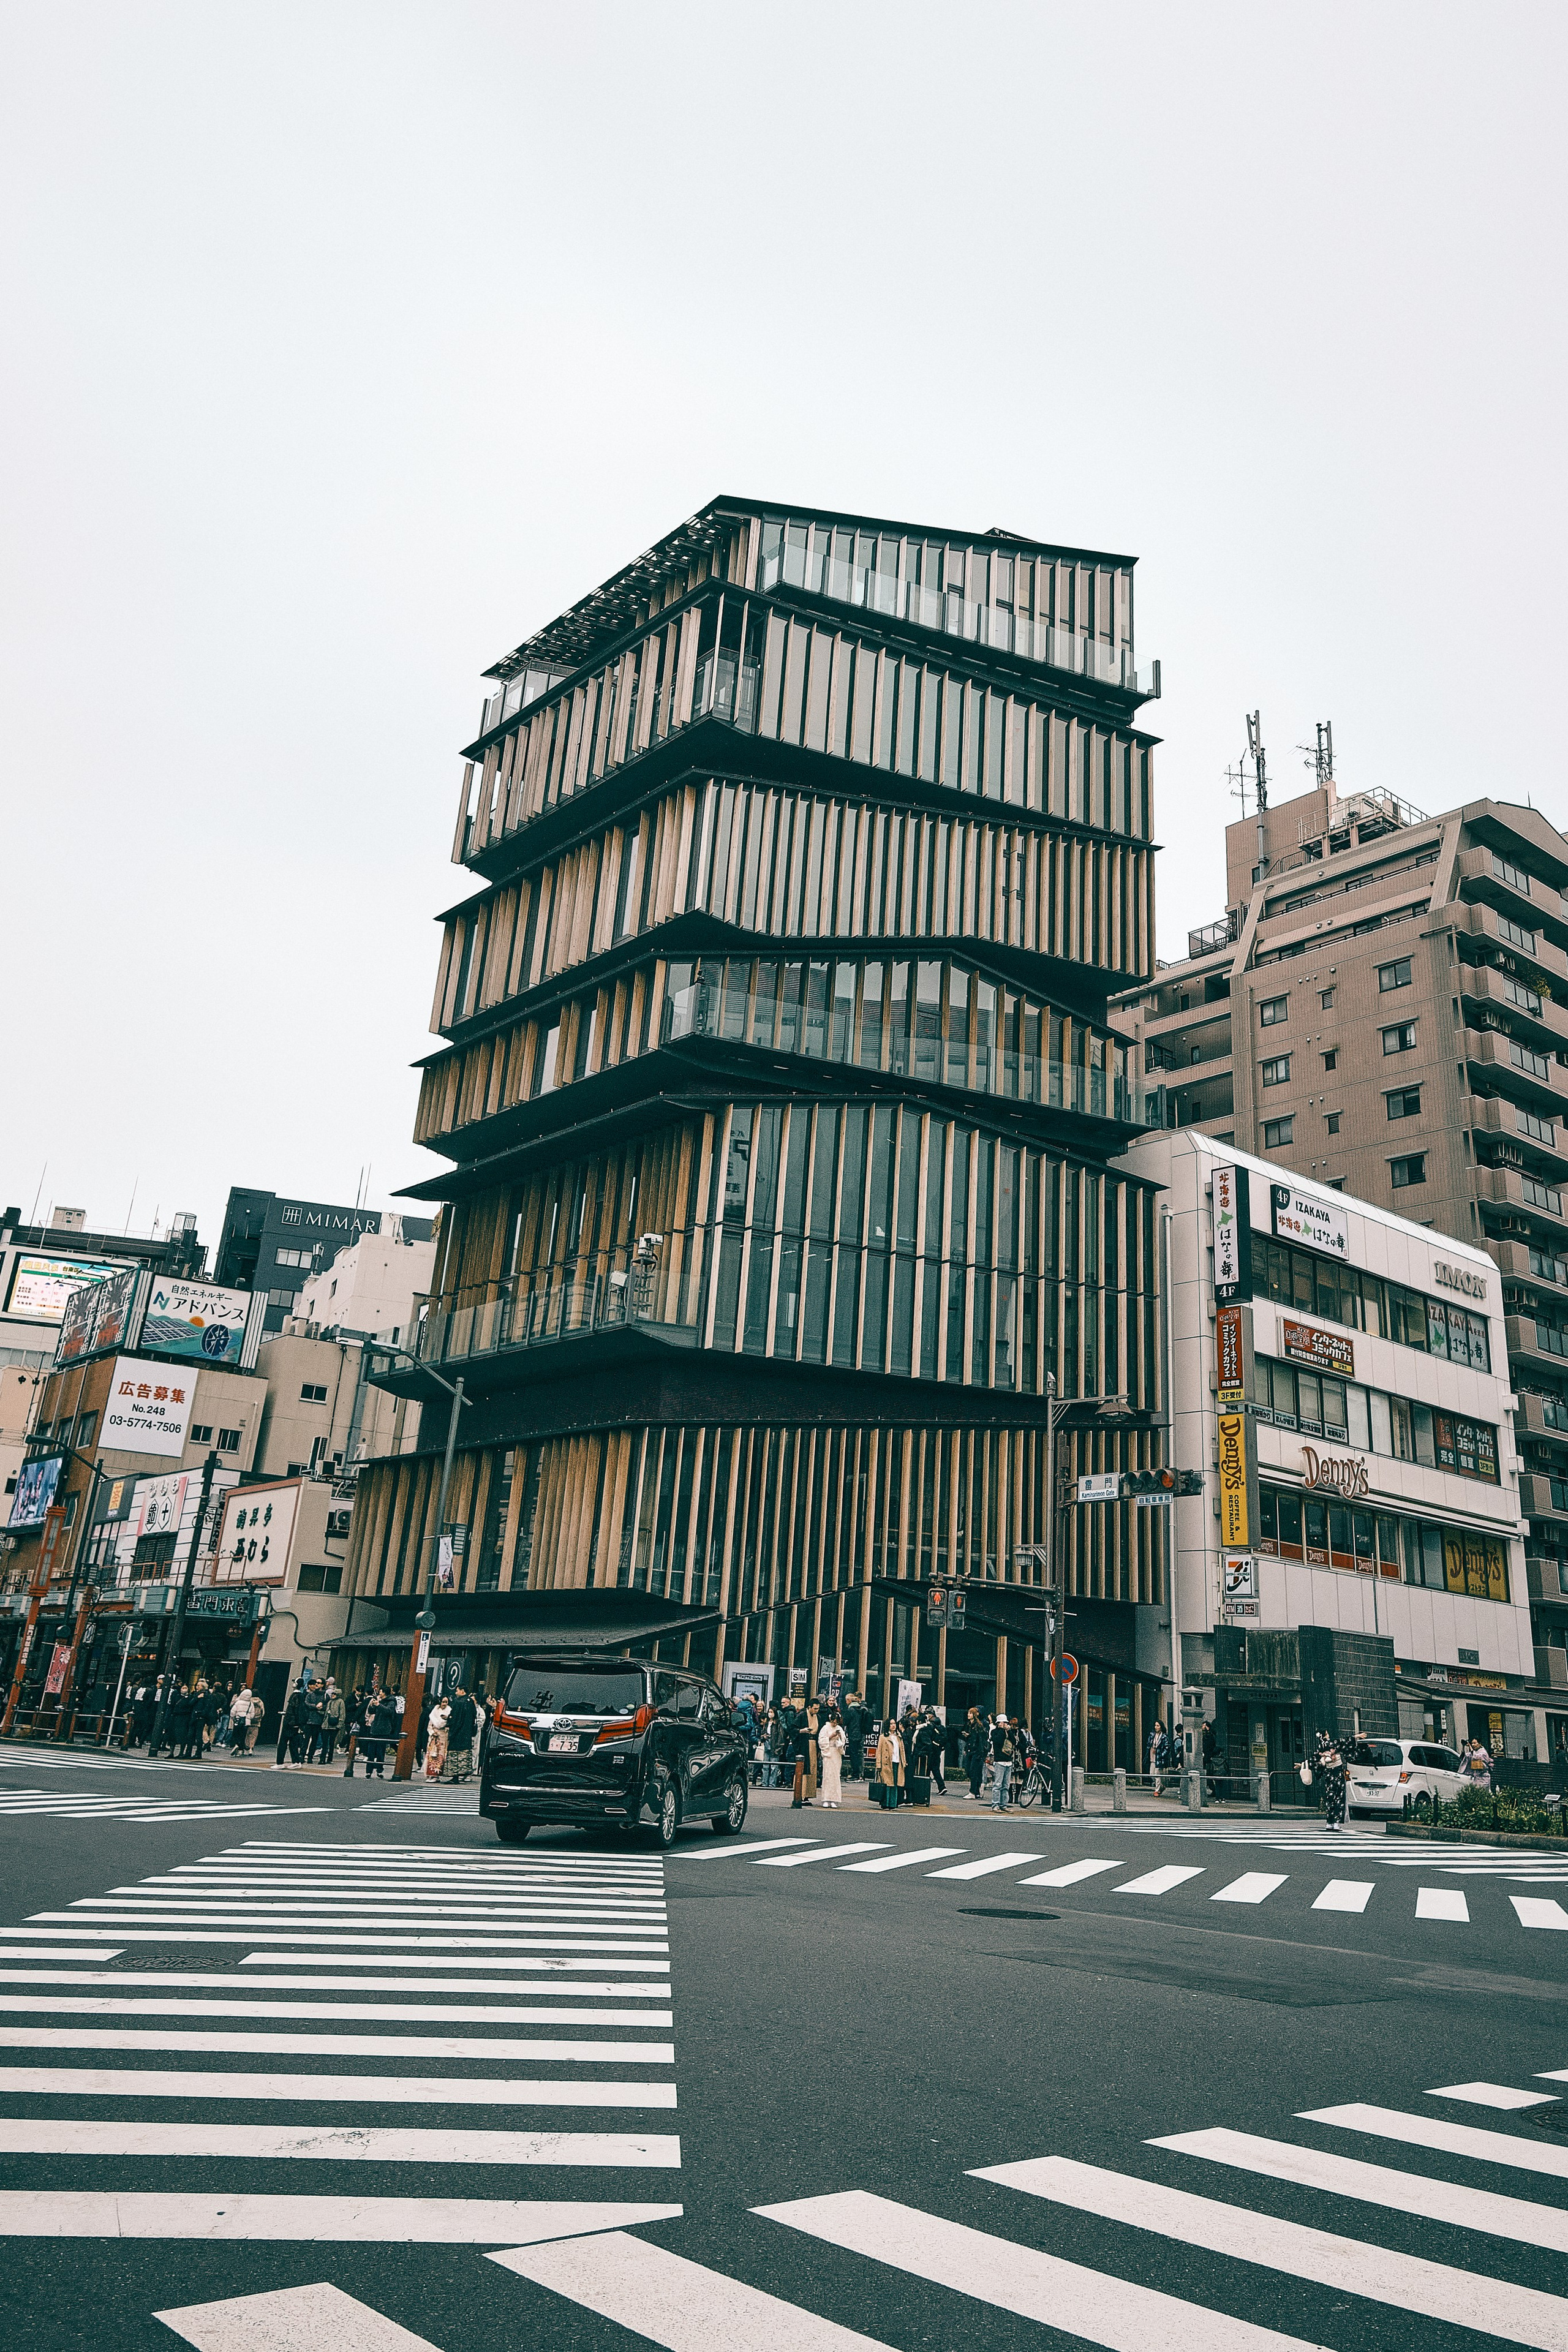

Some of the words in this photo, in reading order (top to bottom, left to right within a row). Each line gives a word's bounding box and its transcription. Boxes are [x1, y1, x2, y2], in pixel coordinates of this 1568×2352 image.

[1277, 1189, 1289, 1204] 4F
[1295, 1200, 1330, 1224] IZAKAYA
[1278, 1215, 1301, 1233] 北海道
[1313, 1227, 1345, 1252] はなの舞
[1220, 1229, 1234, 1279] はなの舞
[1434, 1261, 1487, 1298] IMON
[172, 1284, 233, 1301] 自然エネルギー
[1219, 1285, 1235, 1298] 4F
[173, 1297, 244, 1321] アドバンス
[1311, 1342, 1352, 1362] コミックカフェ
[118, 1381, 186, 1404] 広告募集
[1221, 1391, 1242, 1400] 3F受付
[132, 1404, 165, 1415] No.248
[110, 1415, 181, 1433] 03-5774-7506
[1220, 1417, 1245, 1490] Denny's
[1299, 1446, 1369, 1499] Denny's
[1085, 1477, 1112, 1490] 雷門
[1259, 1541, 1273, 1552] enny's
